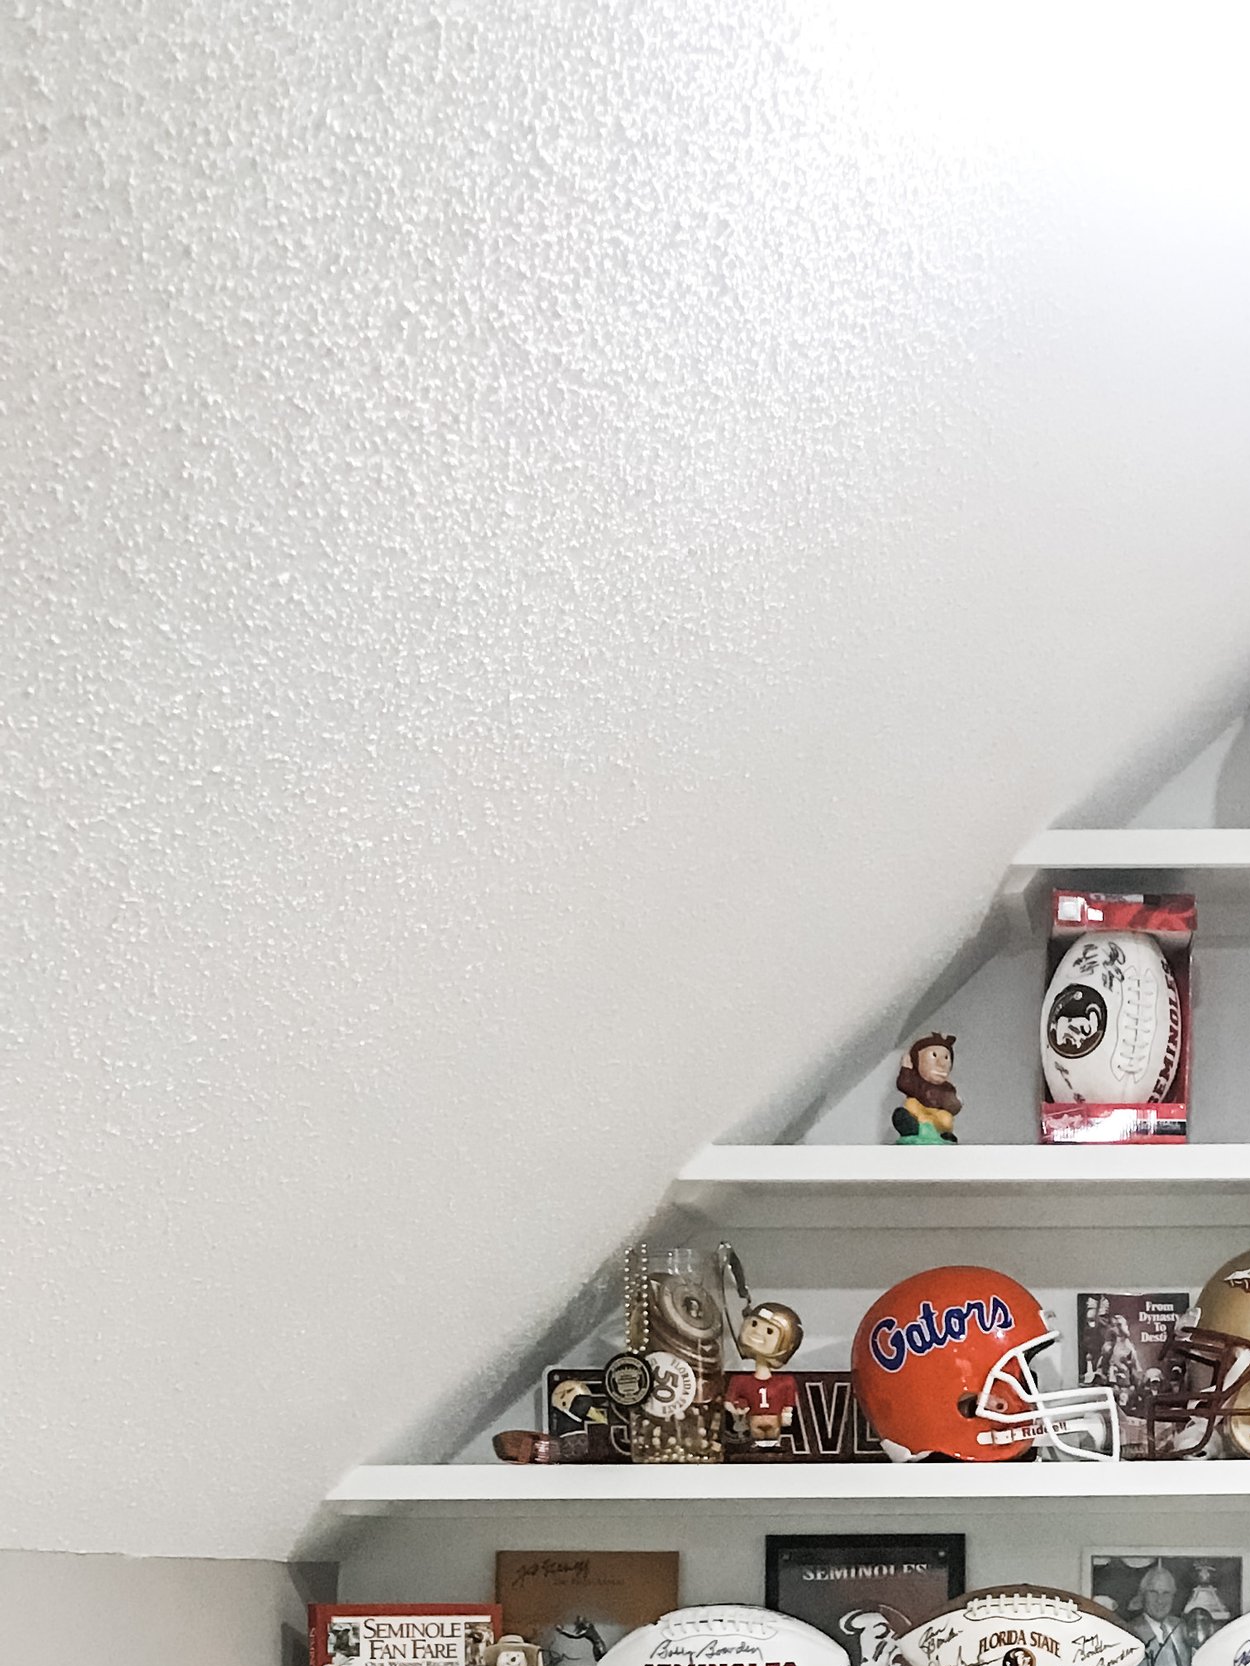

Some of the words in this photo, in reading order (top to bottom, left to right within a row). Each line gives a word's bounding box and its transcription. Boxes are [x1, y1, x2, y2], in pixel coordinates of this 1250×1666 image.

[1146, 1301, 1175, 1312] From
[870, 1294, 1015, 1373] Gators
[1154, 1322, 1168, 1332] To
[652, 1365, 680, 1404] 50
[757, 1386, 771, 1410] 1
[363, 1619, 462, 1640] SEMINOLE
[369, 1640, 407, 1660] FAN
[411, 1640, 458, 1660] FARE
[978, 1629, 1028, 1655] FLORIDA
[1030, 1631, 1063, 1659] STATE
